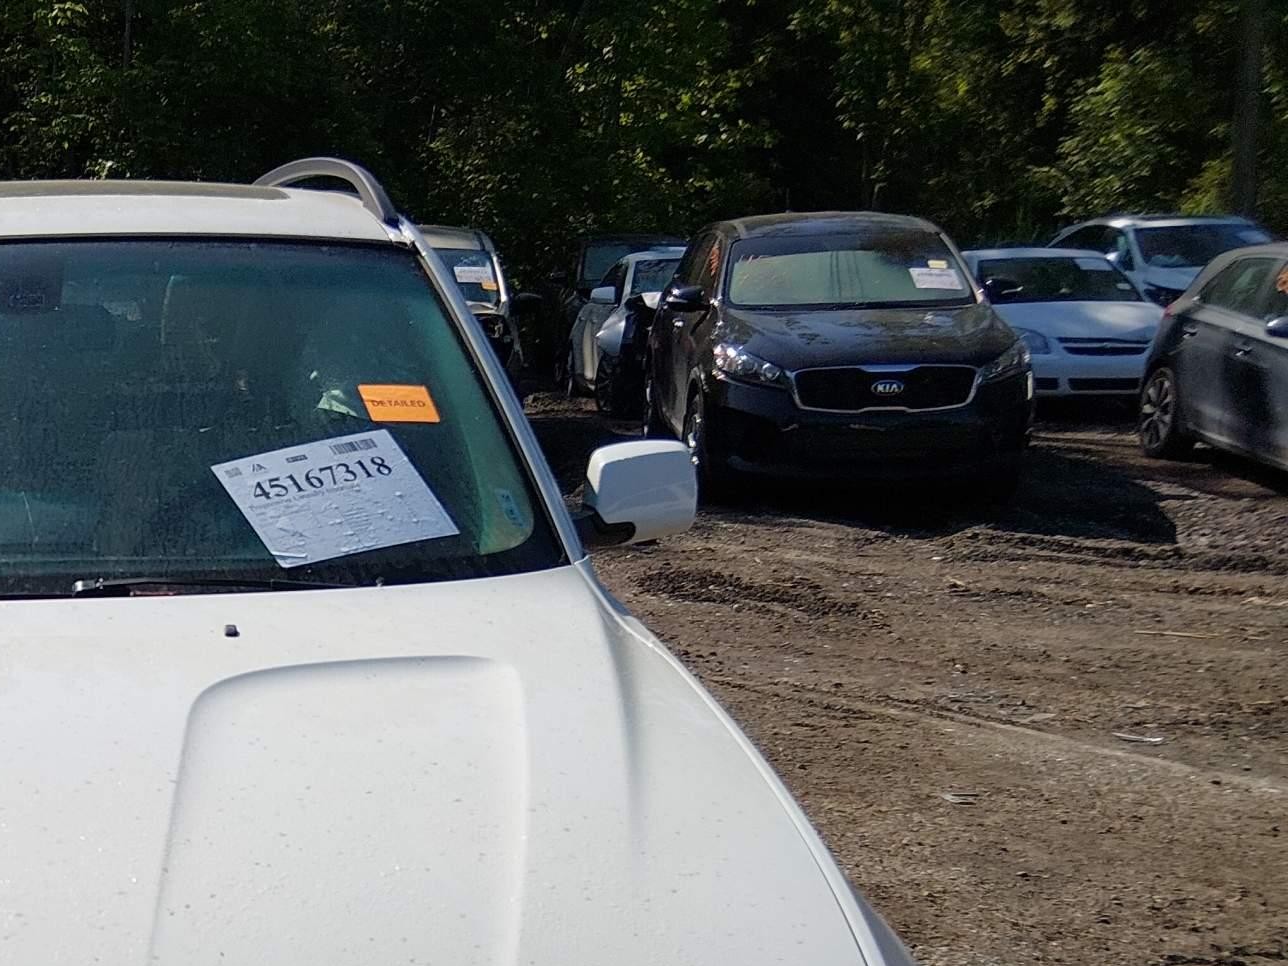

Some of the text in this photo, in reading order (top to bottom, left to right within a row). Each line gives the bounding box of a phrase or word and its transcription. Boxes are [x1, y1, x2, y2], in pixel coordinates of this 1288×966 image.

[876, 383, 899, 393] KIA
[371, 399, 427, 408] DETAILED
[253, 455, 393, 500] 45167318
